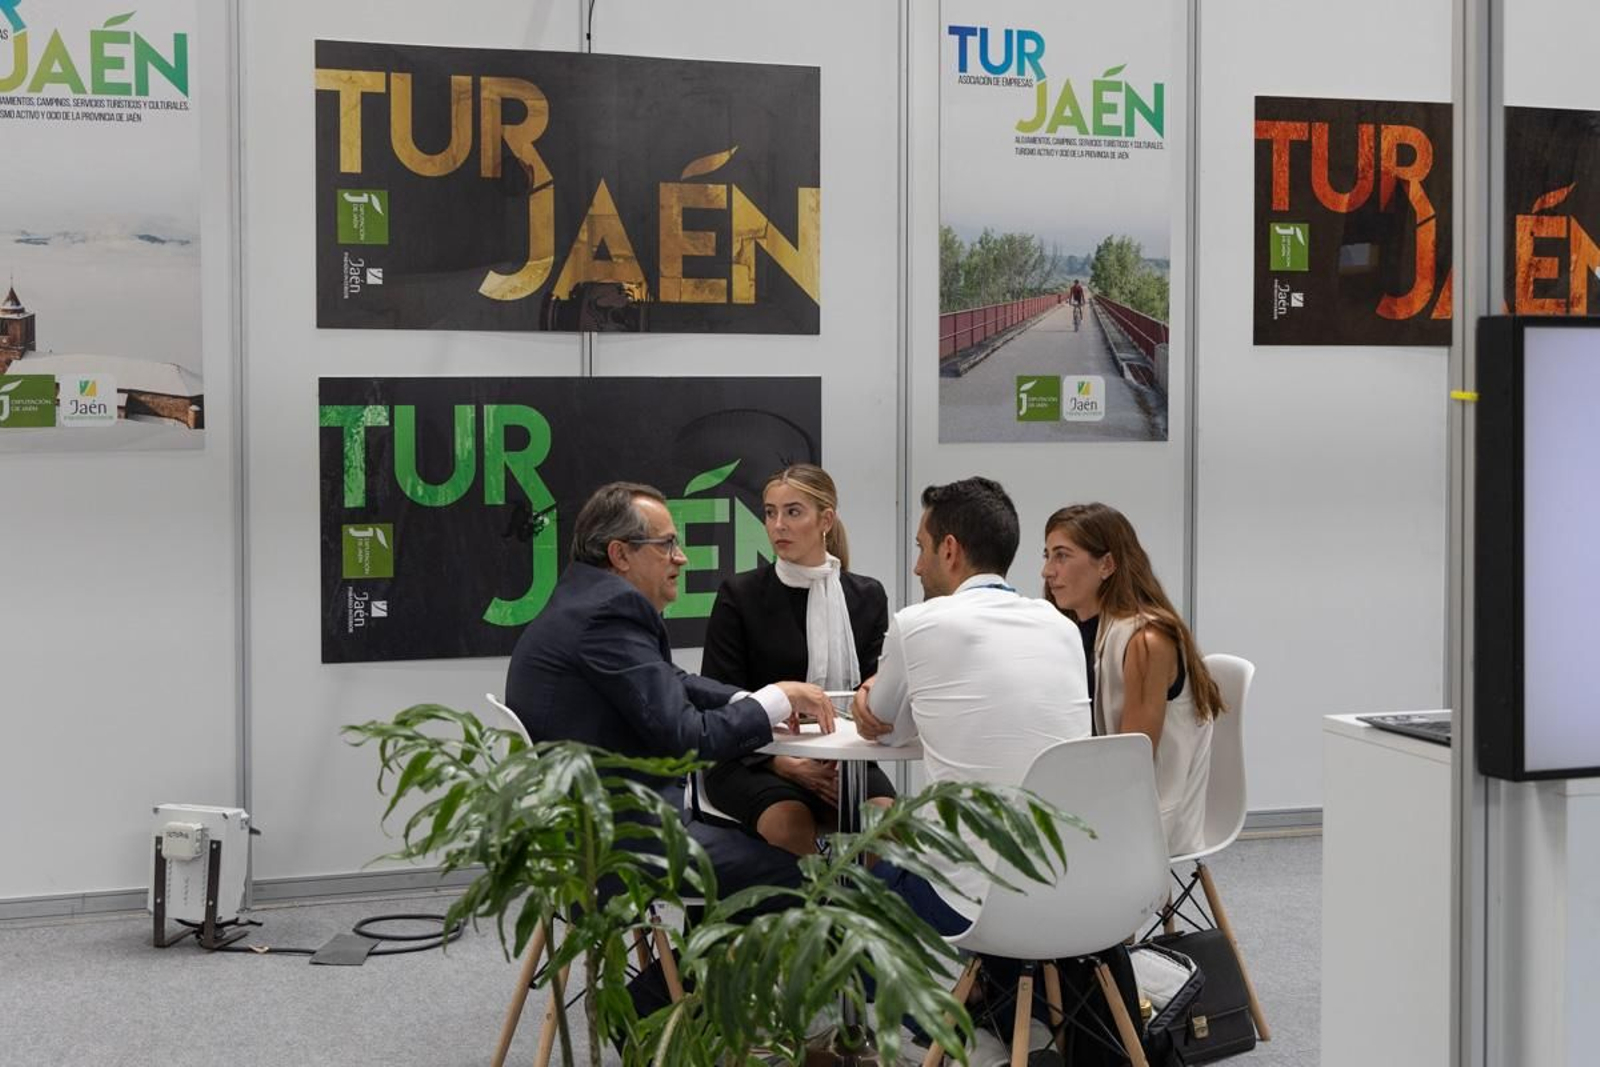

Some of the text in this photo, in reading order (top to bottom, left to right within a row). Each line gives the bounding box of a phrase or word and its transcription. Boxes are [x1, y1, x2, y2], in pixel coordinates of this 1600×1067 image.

[0, 10, 189, 98] JAÉN
[948, 25, 1046, 82] TUR
[1001, 77, 1034, 88] EMPRESAS
[16, 110, 40, 119] ACTIVO
[41, 111, 46, 119] Y
[46, 111, 61, 120] OCIO
[62, 112, 71, 120] DE
[72, 112, 80, 120] LA
[81, 112, 115, 121] PROVINCIA
[116, 112, 124, 121] DE
[73, 98, 105, 107] SERVICIOS
[1015, 63, 1164, 139] JAÉN
[315, 68, 553, 193] TUR
[1254, 120, 1436, 225] TUR
[479, 146, 820, 305] JAÉN
[349, 258, 365, 294] Jaén
[1278, 285, 1290, 314] Jaén
[70, 399, 107, 415] Jaén
[1070, 397, 1098, 411] Jaén
[319, 405, 556, 511] TUR
[354, 592, 369, 627] Jaén
